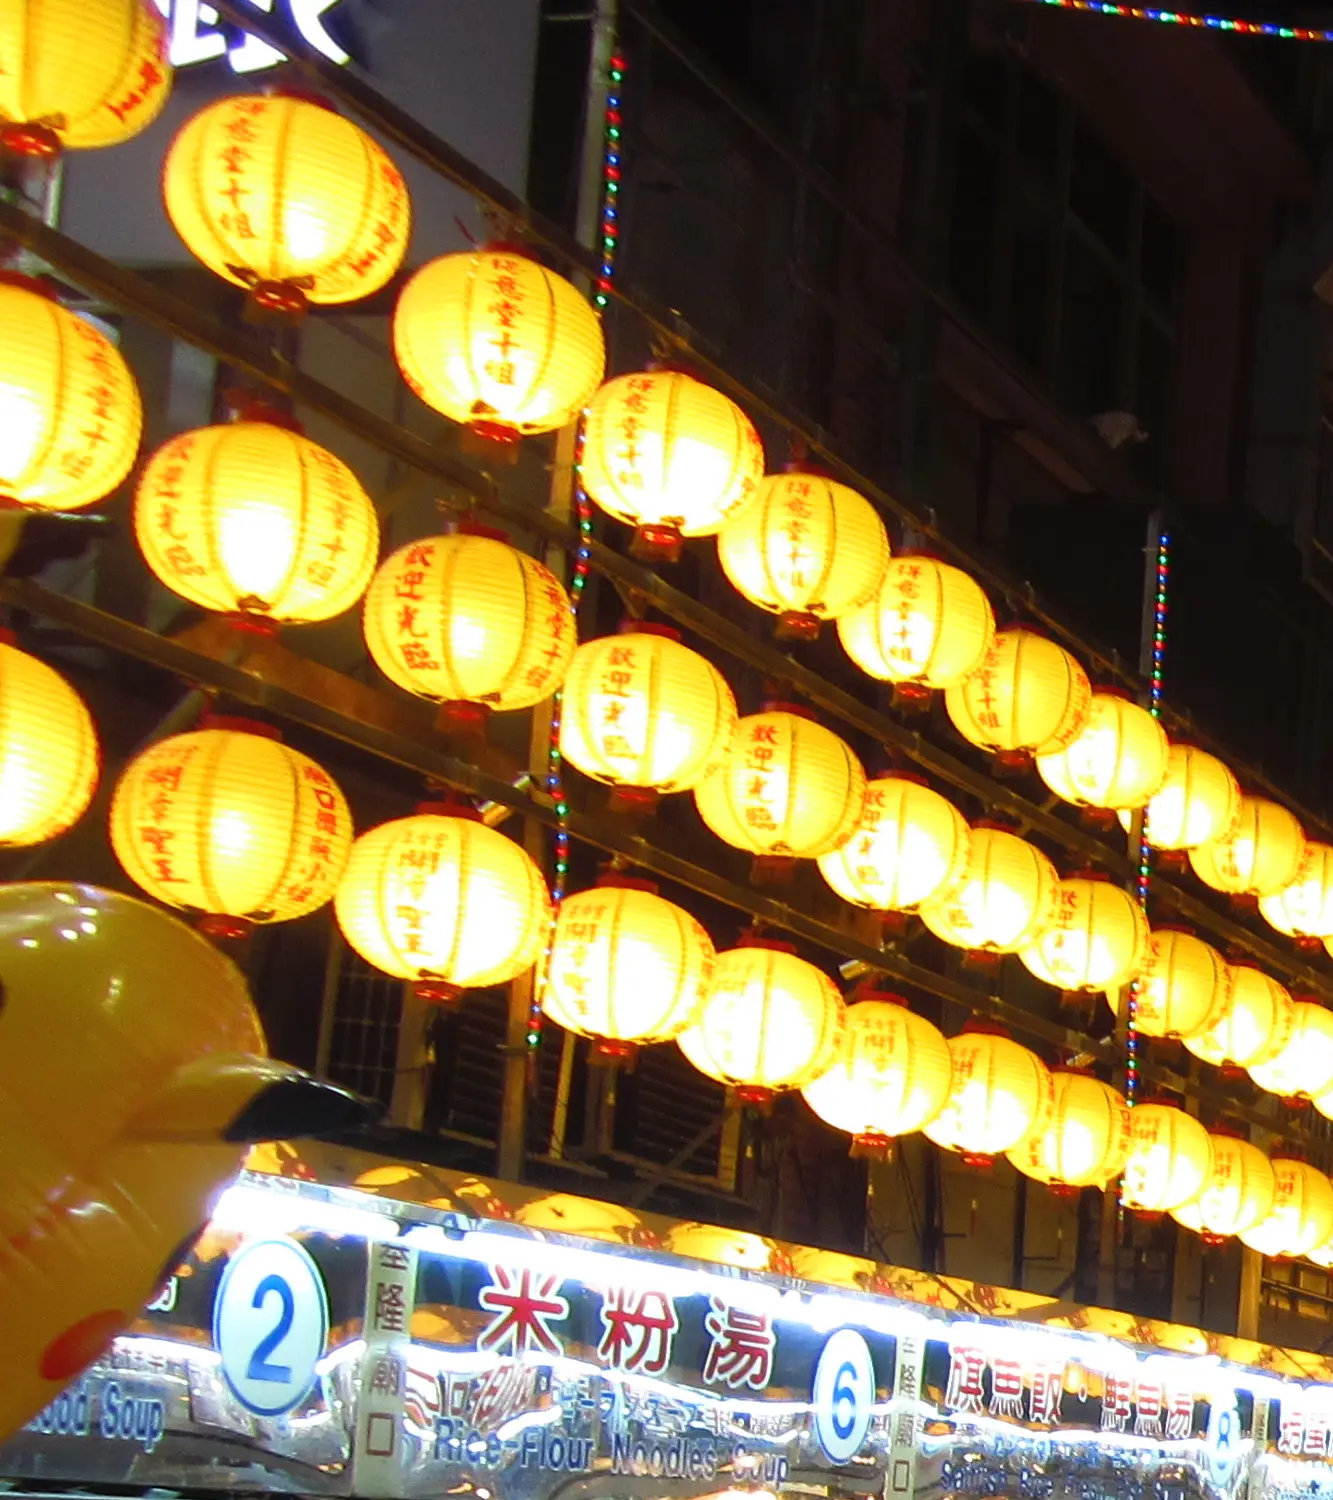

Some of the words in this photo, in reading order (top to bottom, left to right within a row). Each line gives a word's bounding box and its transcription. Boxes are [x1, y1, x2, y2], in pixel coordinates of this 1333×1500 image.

[248, 1276, 295, 1383] 2
[479, 1263, 776, 1391] 米粉湯
[100, 1380, 164, 1454] Soup
[832, 1361, 858, 1440] 6
[610, 1432, 717, 1480] Noodles
